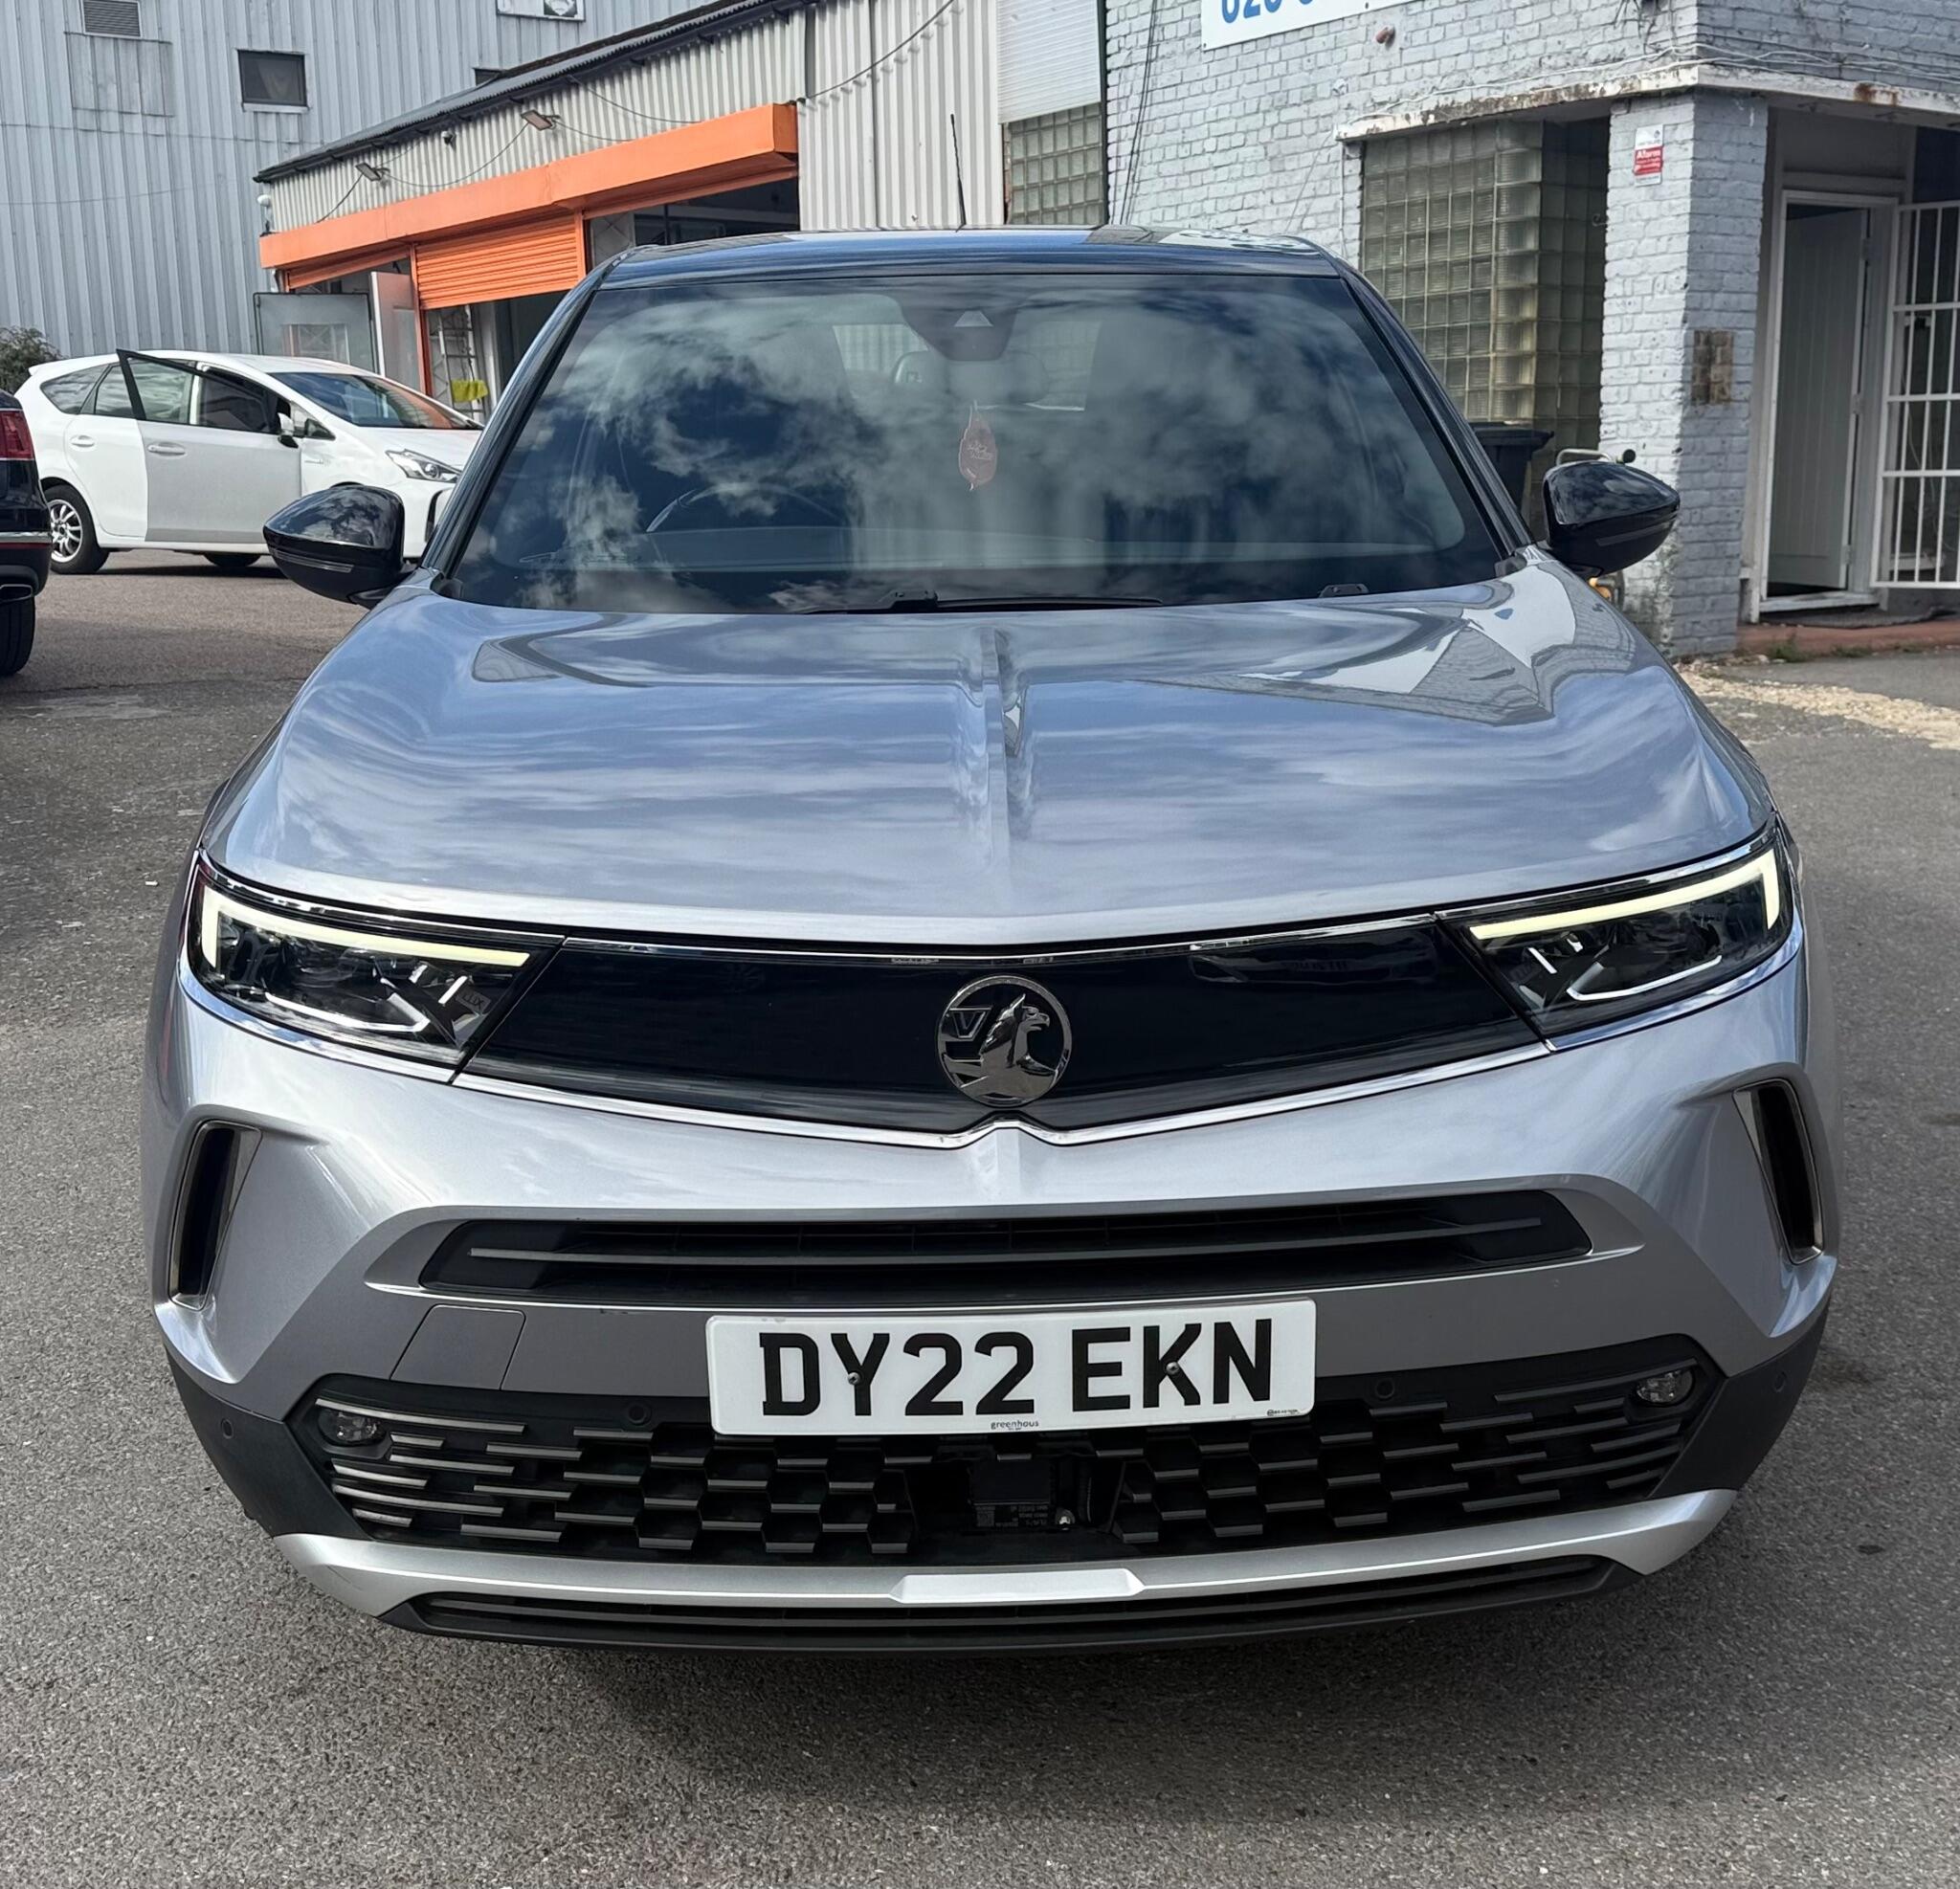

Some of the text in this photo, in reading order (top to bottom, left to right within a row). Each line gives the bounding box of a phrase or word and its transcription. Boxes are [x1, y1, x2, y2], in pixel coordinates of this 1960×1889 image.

[759, 1318, 1273, 1416] DY22 EKN
[991, 1419, 1039, 1430] greenhous
